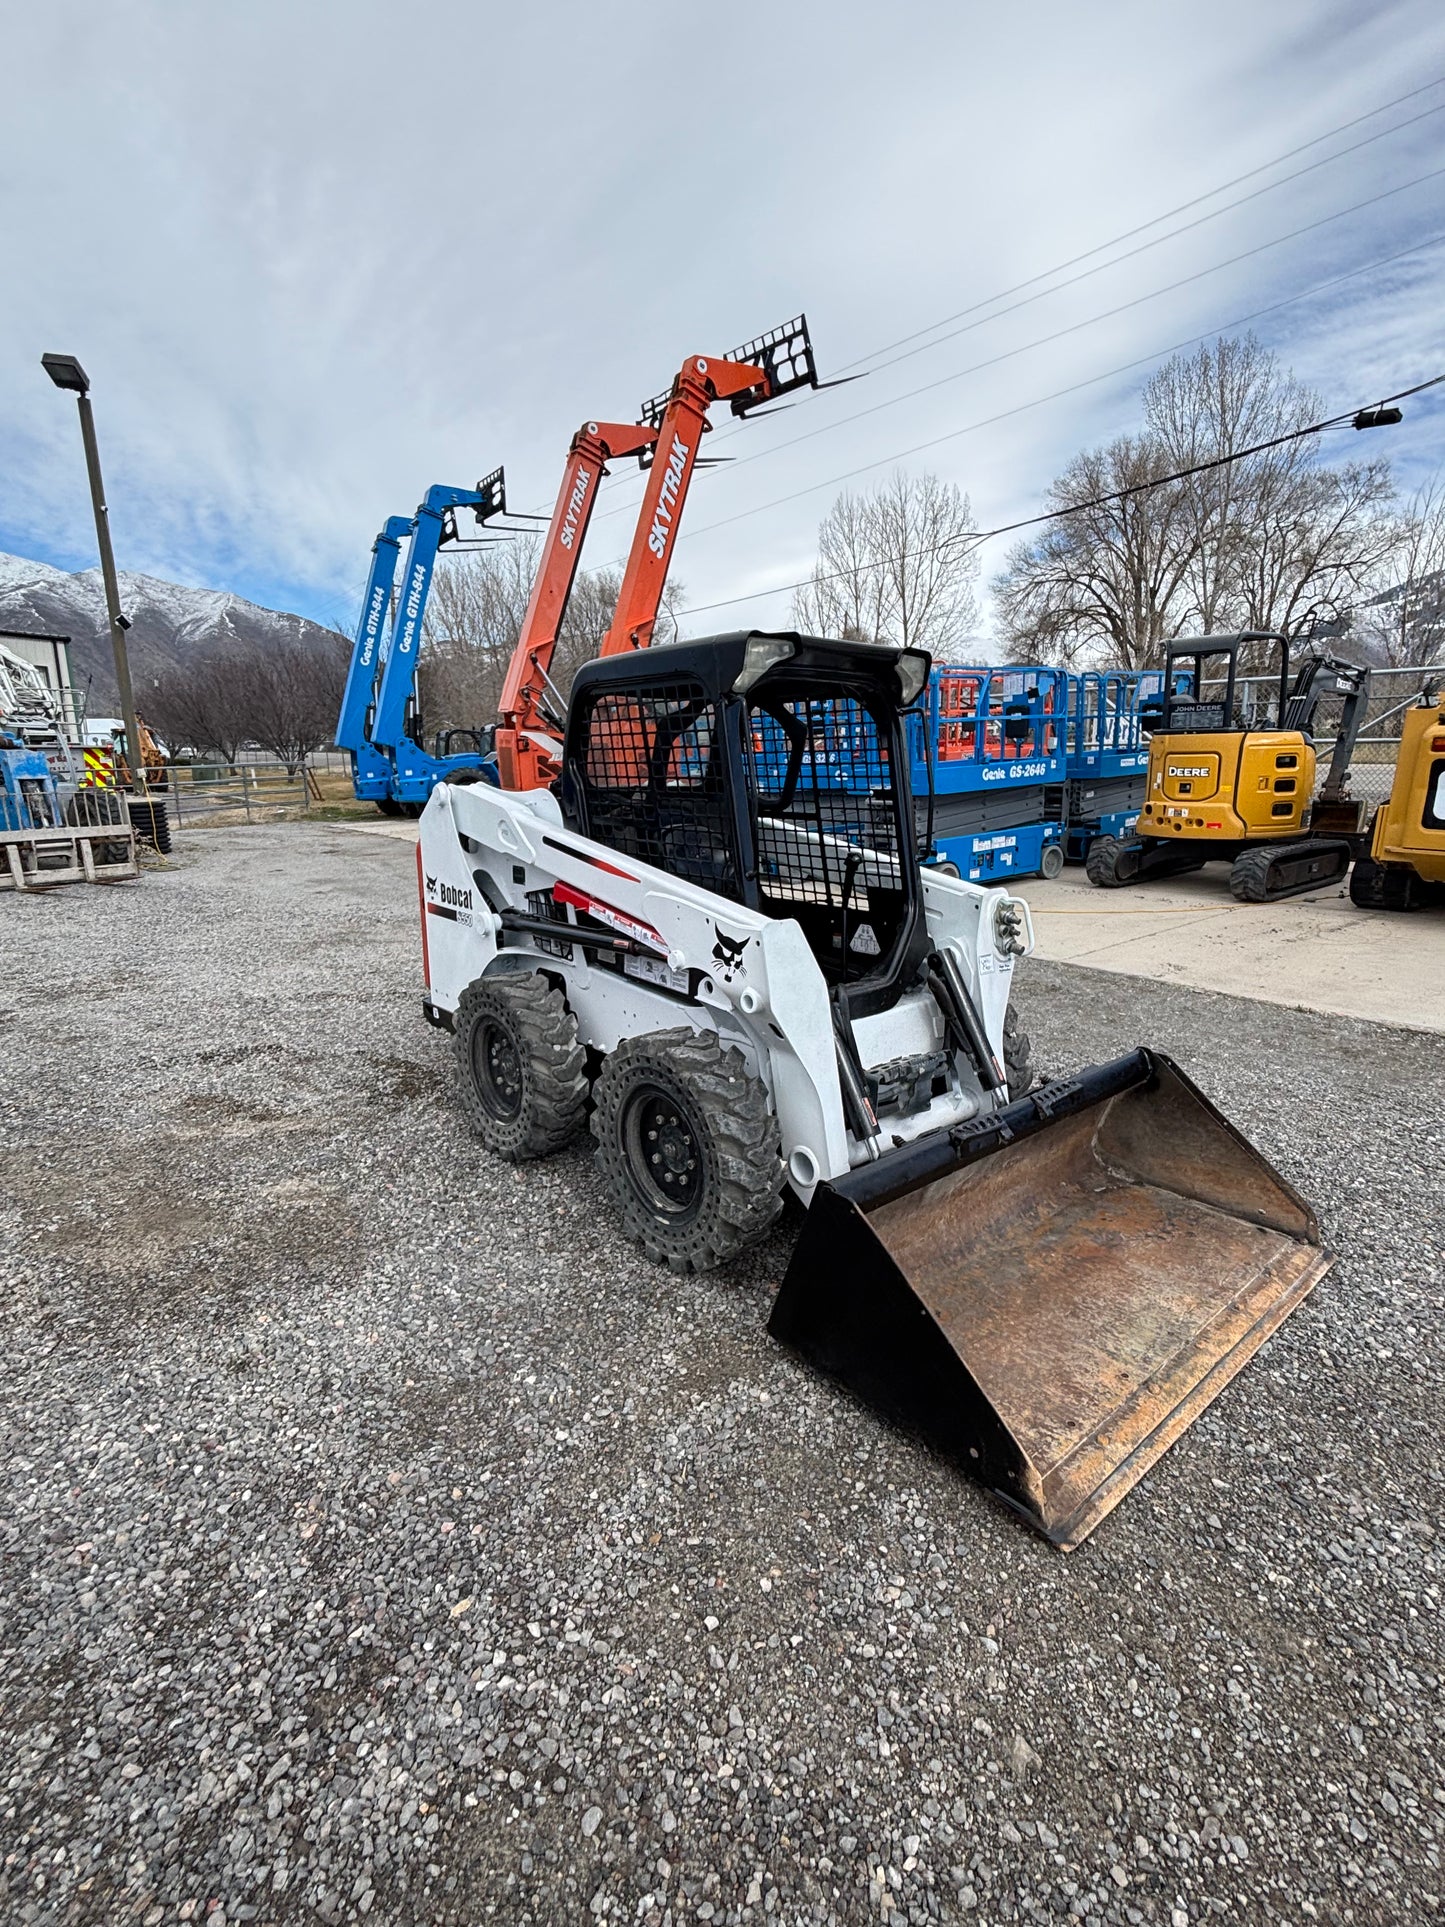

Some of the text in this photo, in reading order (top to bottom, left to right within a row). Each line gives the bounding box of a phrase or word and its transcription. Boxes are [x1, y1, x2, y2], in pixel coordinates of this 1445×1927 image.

[560, 464, 591, 550] SKYTRAK
[648, 432, 689, 559] SKYTRAK
[360, 586, 385, 666] Genie GTH-844
[399, 563, 426, 653] Genie GTH-844
[1196, 704, 1222, 712] DEERE
[982, 767, 1006, 781] Genie
[1009, 763, 1046, 778] GS-2646
[1168, 765, 1210, 777] DEERE
[440, 883, 473, 910] Bobcat
